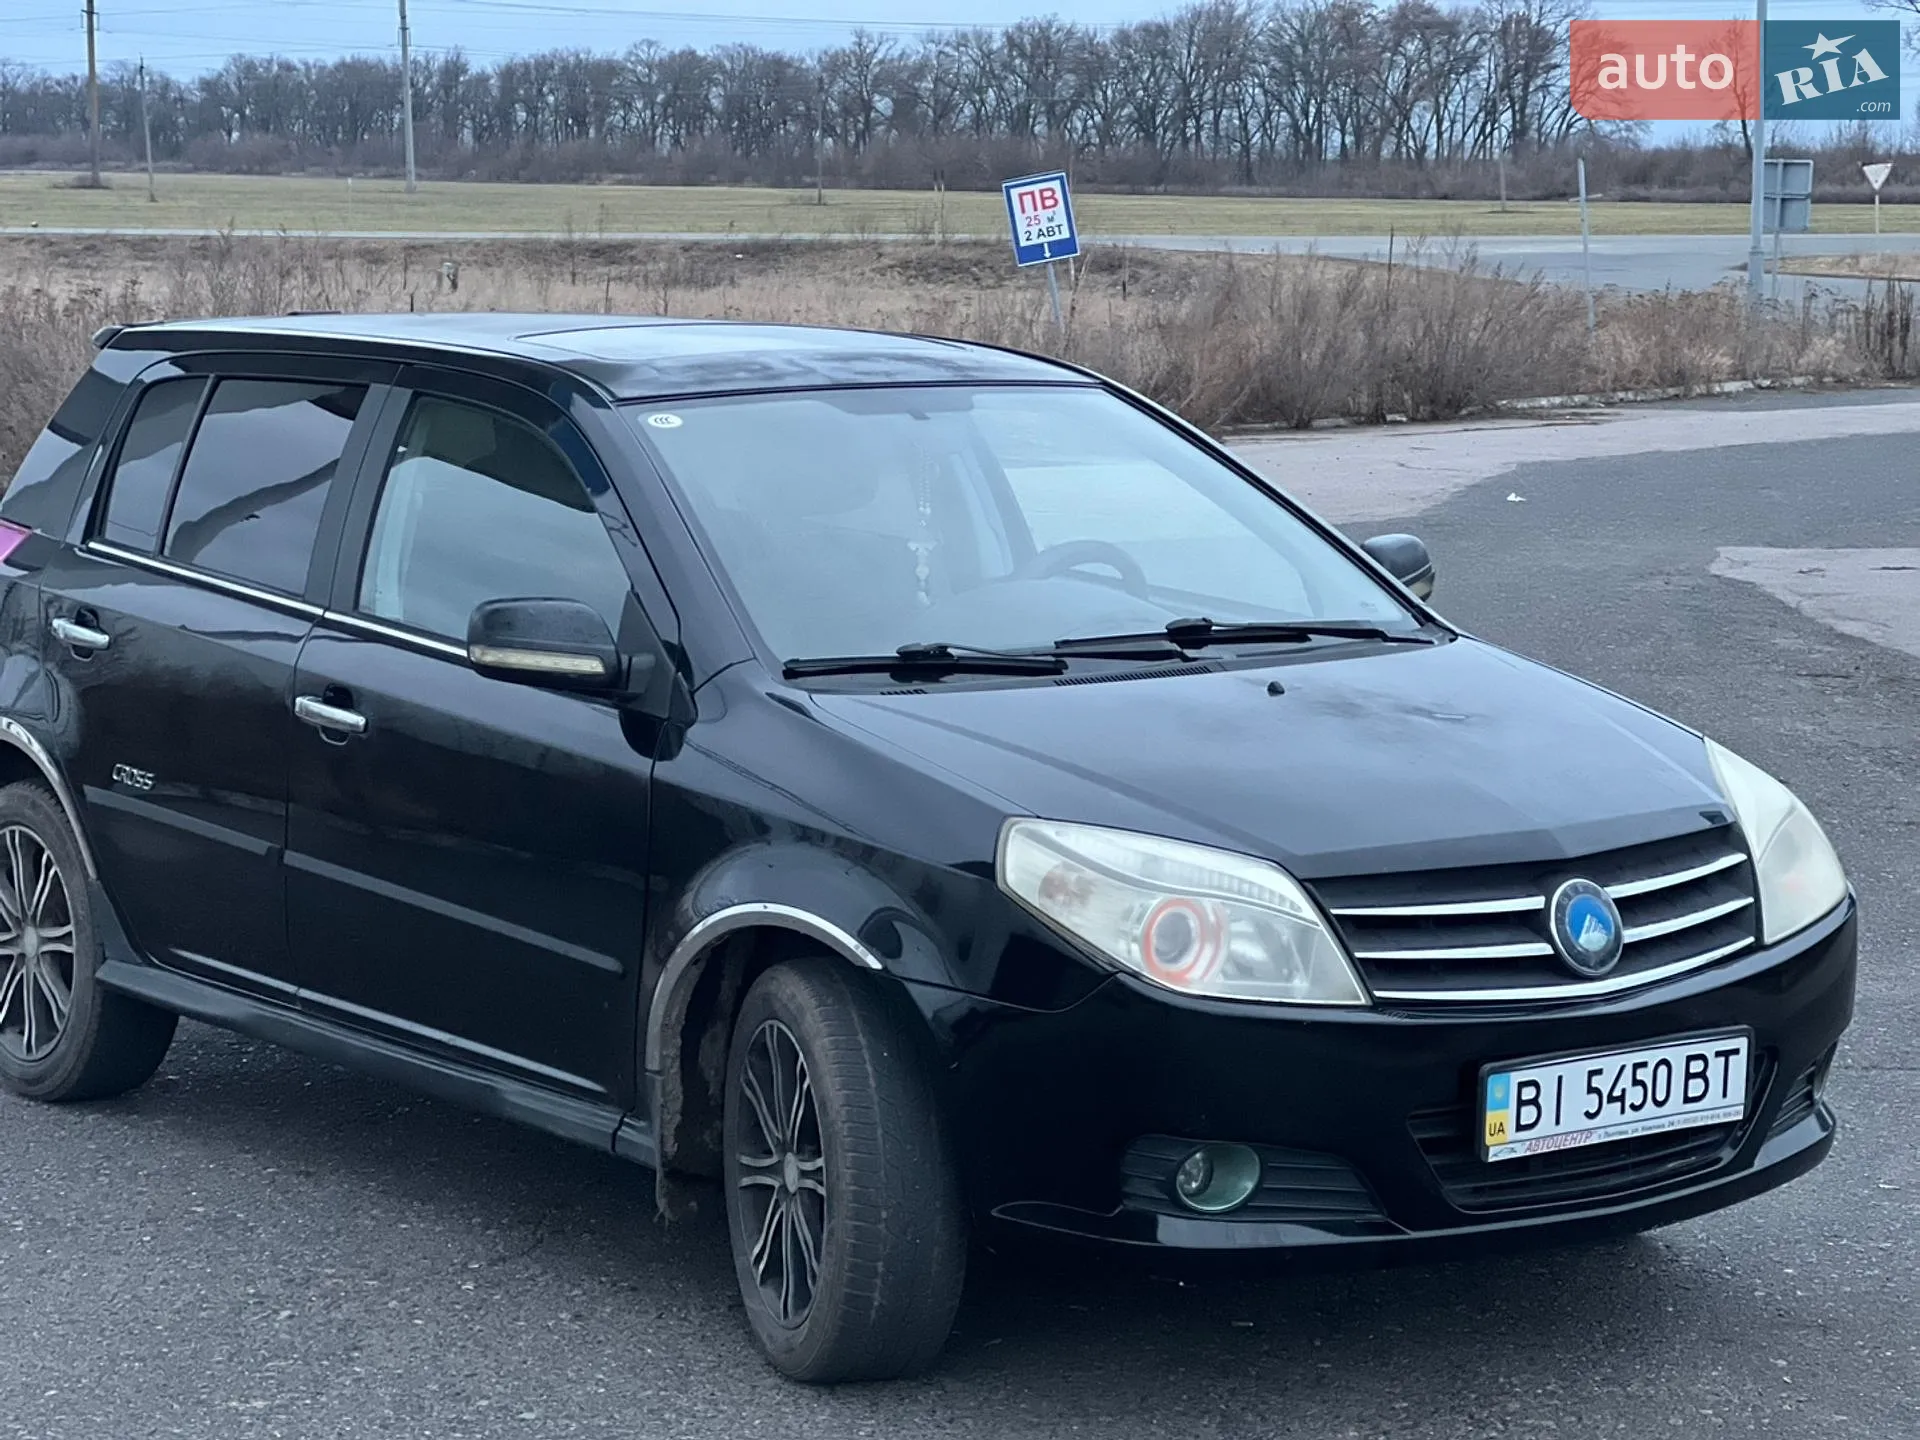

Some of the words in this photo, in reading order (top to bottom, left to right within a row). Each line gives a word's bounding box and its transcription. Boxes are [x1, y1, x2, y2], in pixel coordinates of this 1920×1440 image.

[1018, 186, 1059, 215] ПВ
[1025, 214, 1041, 227] 25
[1024, 230, 1032, 242] 2
[1036, 224, 1063, 240] АВТ
[112, 763, 156, 791] CROSS
[1515, 1074, 1564, 1133] BI
[1583, 1057, 1673, 1120] 5450
[1682, 1047, 1741, 1105] BT
[1488, 1121, 1506, 1137] UA
